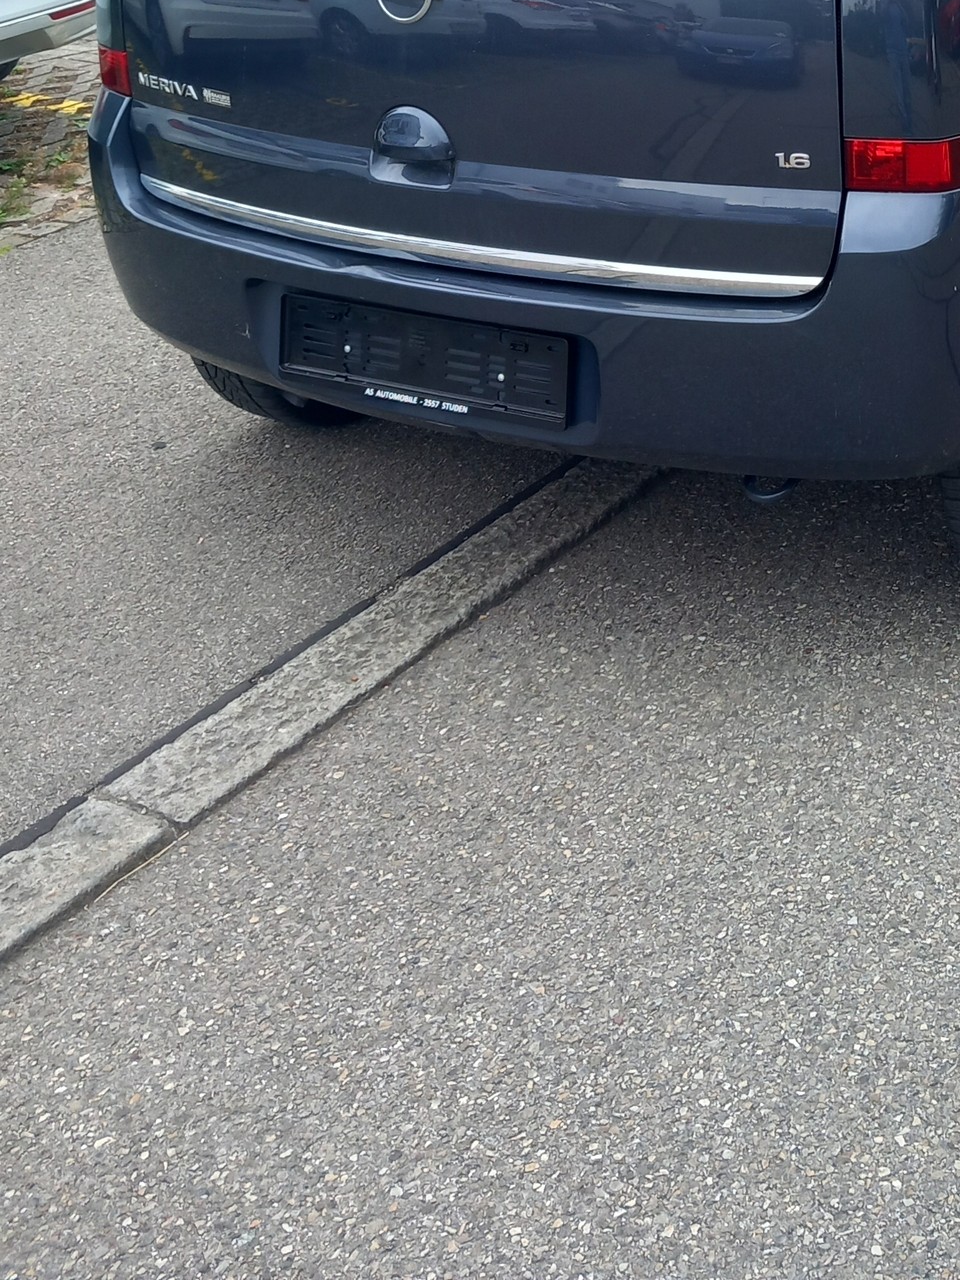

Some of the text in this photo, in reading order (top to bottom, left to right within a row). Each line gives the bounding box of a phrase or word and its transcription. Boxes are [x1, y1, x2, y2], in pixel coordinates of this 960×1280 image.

[138, 72, 199, 100] MERIVA
[365, 387, 375, 396] AS
[375, 389, 418, 405] AUTOMOBILE
[423, 398, 441, 409] 2557
[441, 401, 469, 414] STUDEN
